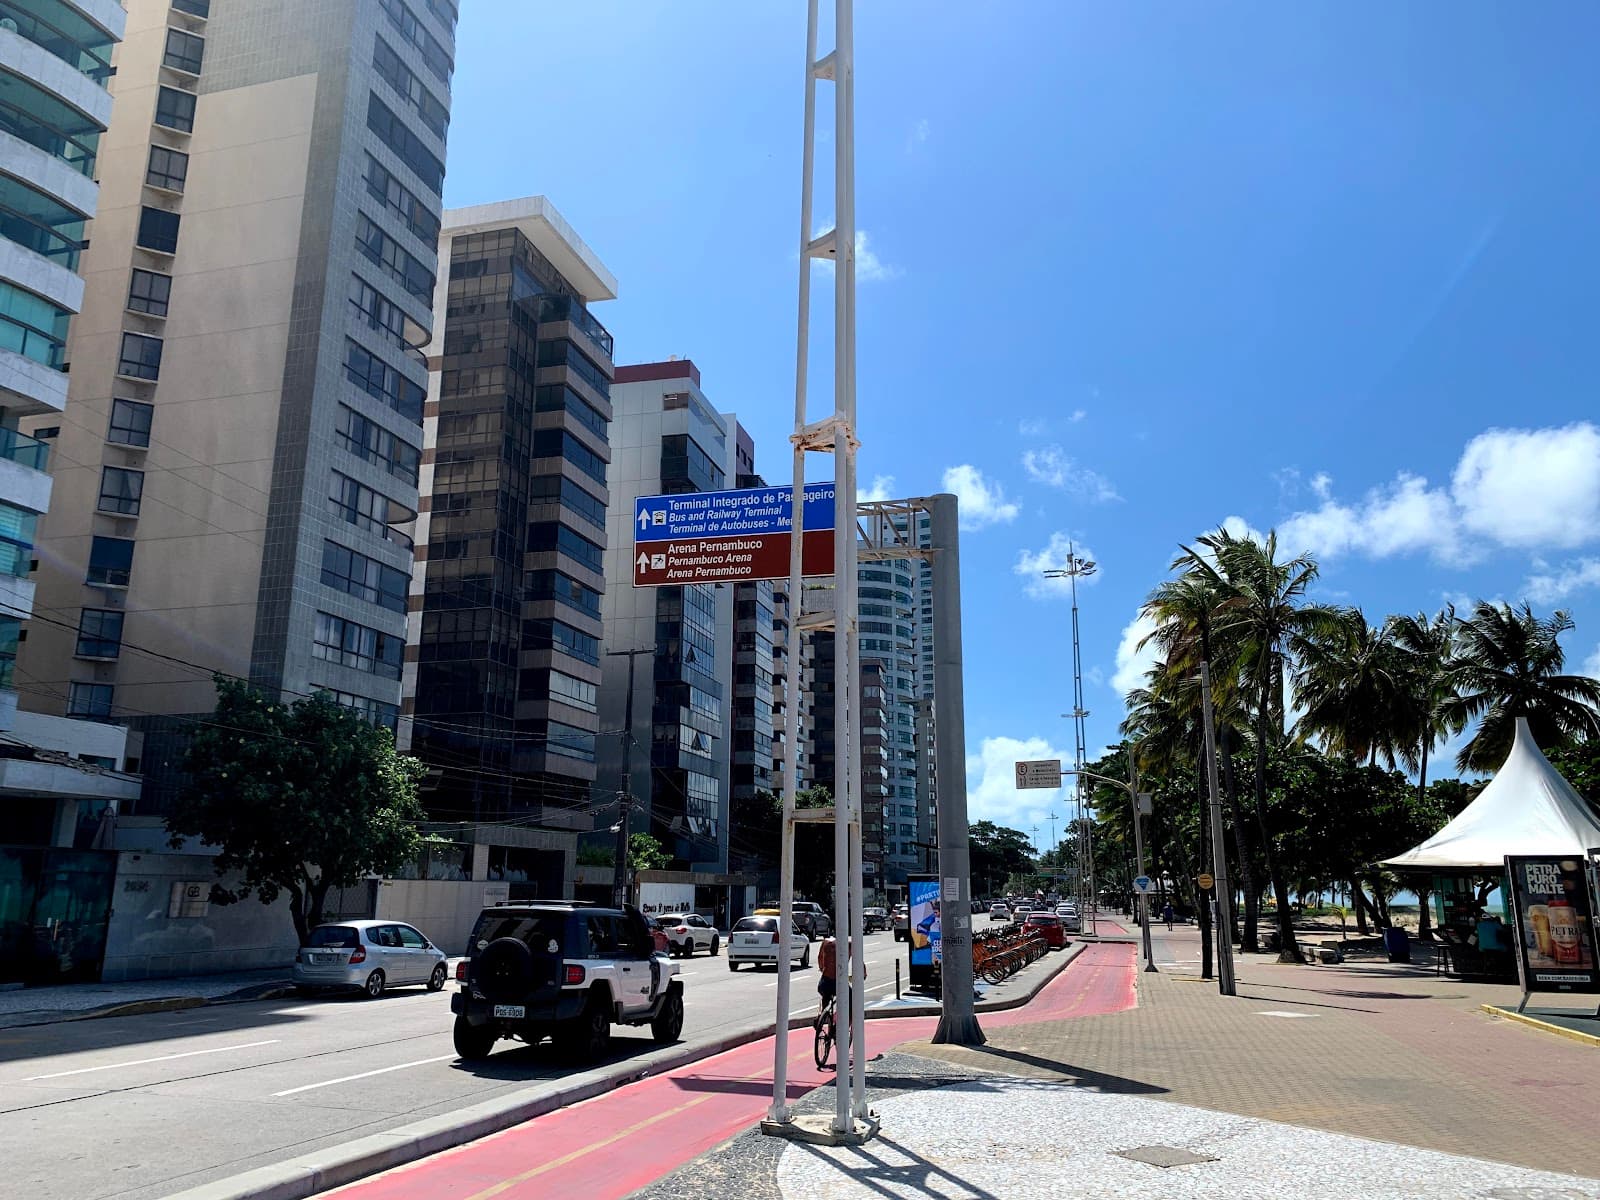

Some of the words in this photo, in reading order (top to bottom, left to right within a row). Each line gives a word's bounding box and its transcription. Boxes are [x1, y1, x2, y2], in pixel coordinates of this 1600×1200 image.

[669, 498, 710, 511] Terminal
[713, 494, 760, 508] Integrado
[763, 493, 775, 504] de
[669, 512, 686, 522] Bus
[688, 510, 705, 520] and
[707, 509, 742, 520] Railway
[744, 505, 783, 517] Terminal
[669, 522, 707, 534] Terminal
[708, 521, 719, 531] de
[720, 519, 769, 531] Autobuses
[667, 543, 697, 555] Arena
[699, 539, 763, 553] Pernambuco
[668, 554, 724, 567] Pernambuco
[725, 552, 752, 563] Arena
[666, 568, 693, 579] Arena
[695, 565, 752, 577] Pernambuco
[1525, 863, 1561, 875] PETRA
[1527, 874, 1557, 884] PURO
[1528, 883, 1565, 895] MALTE
